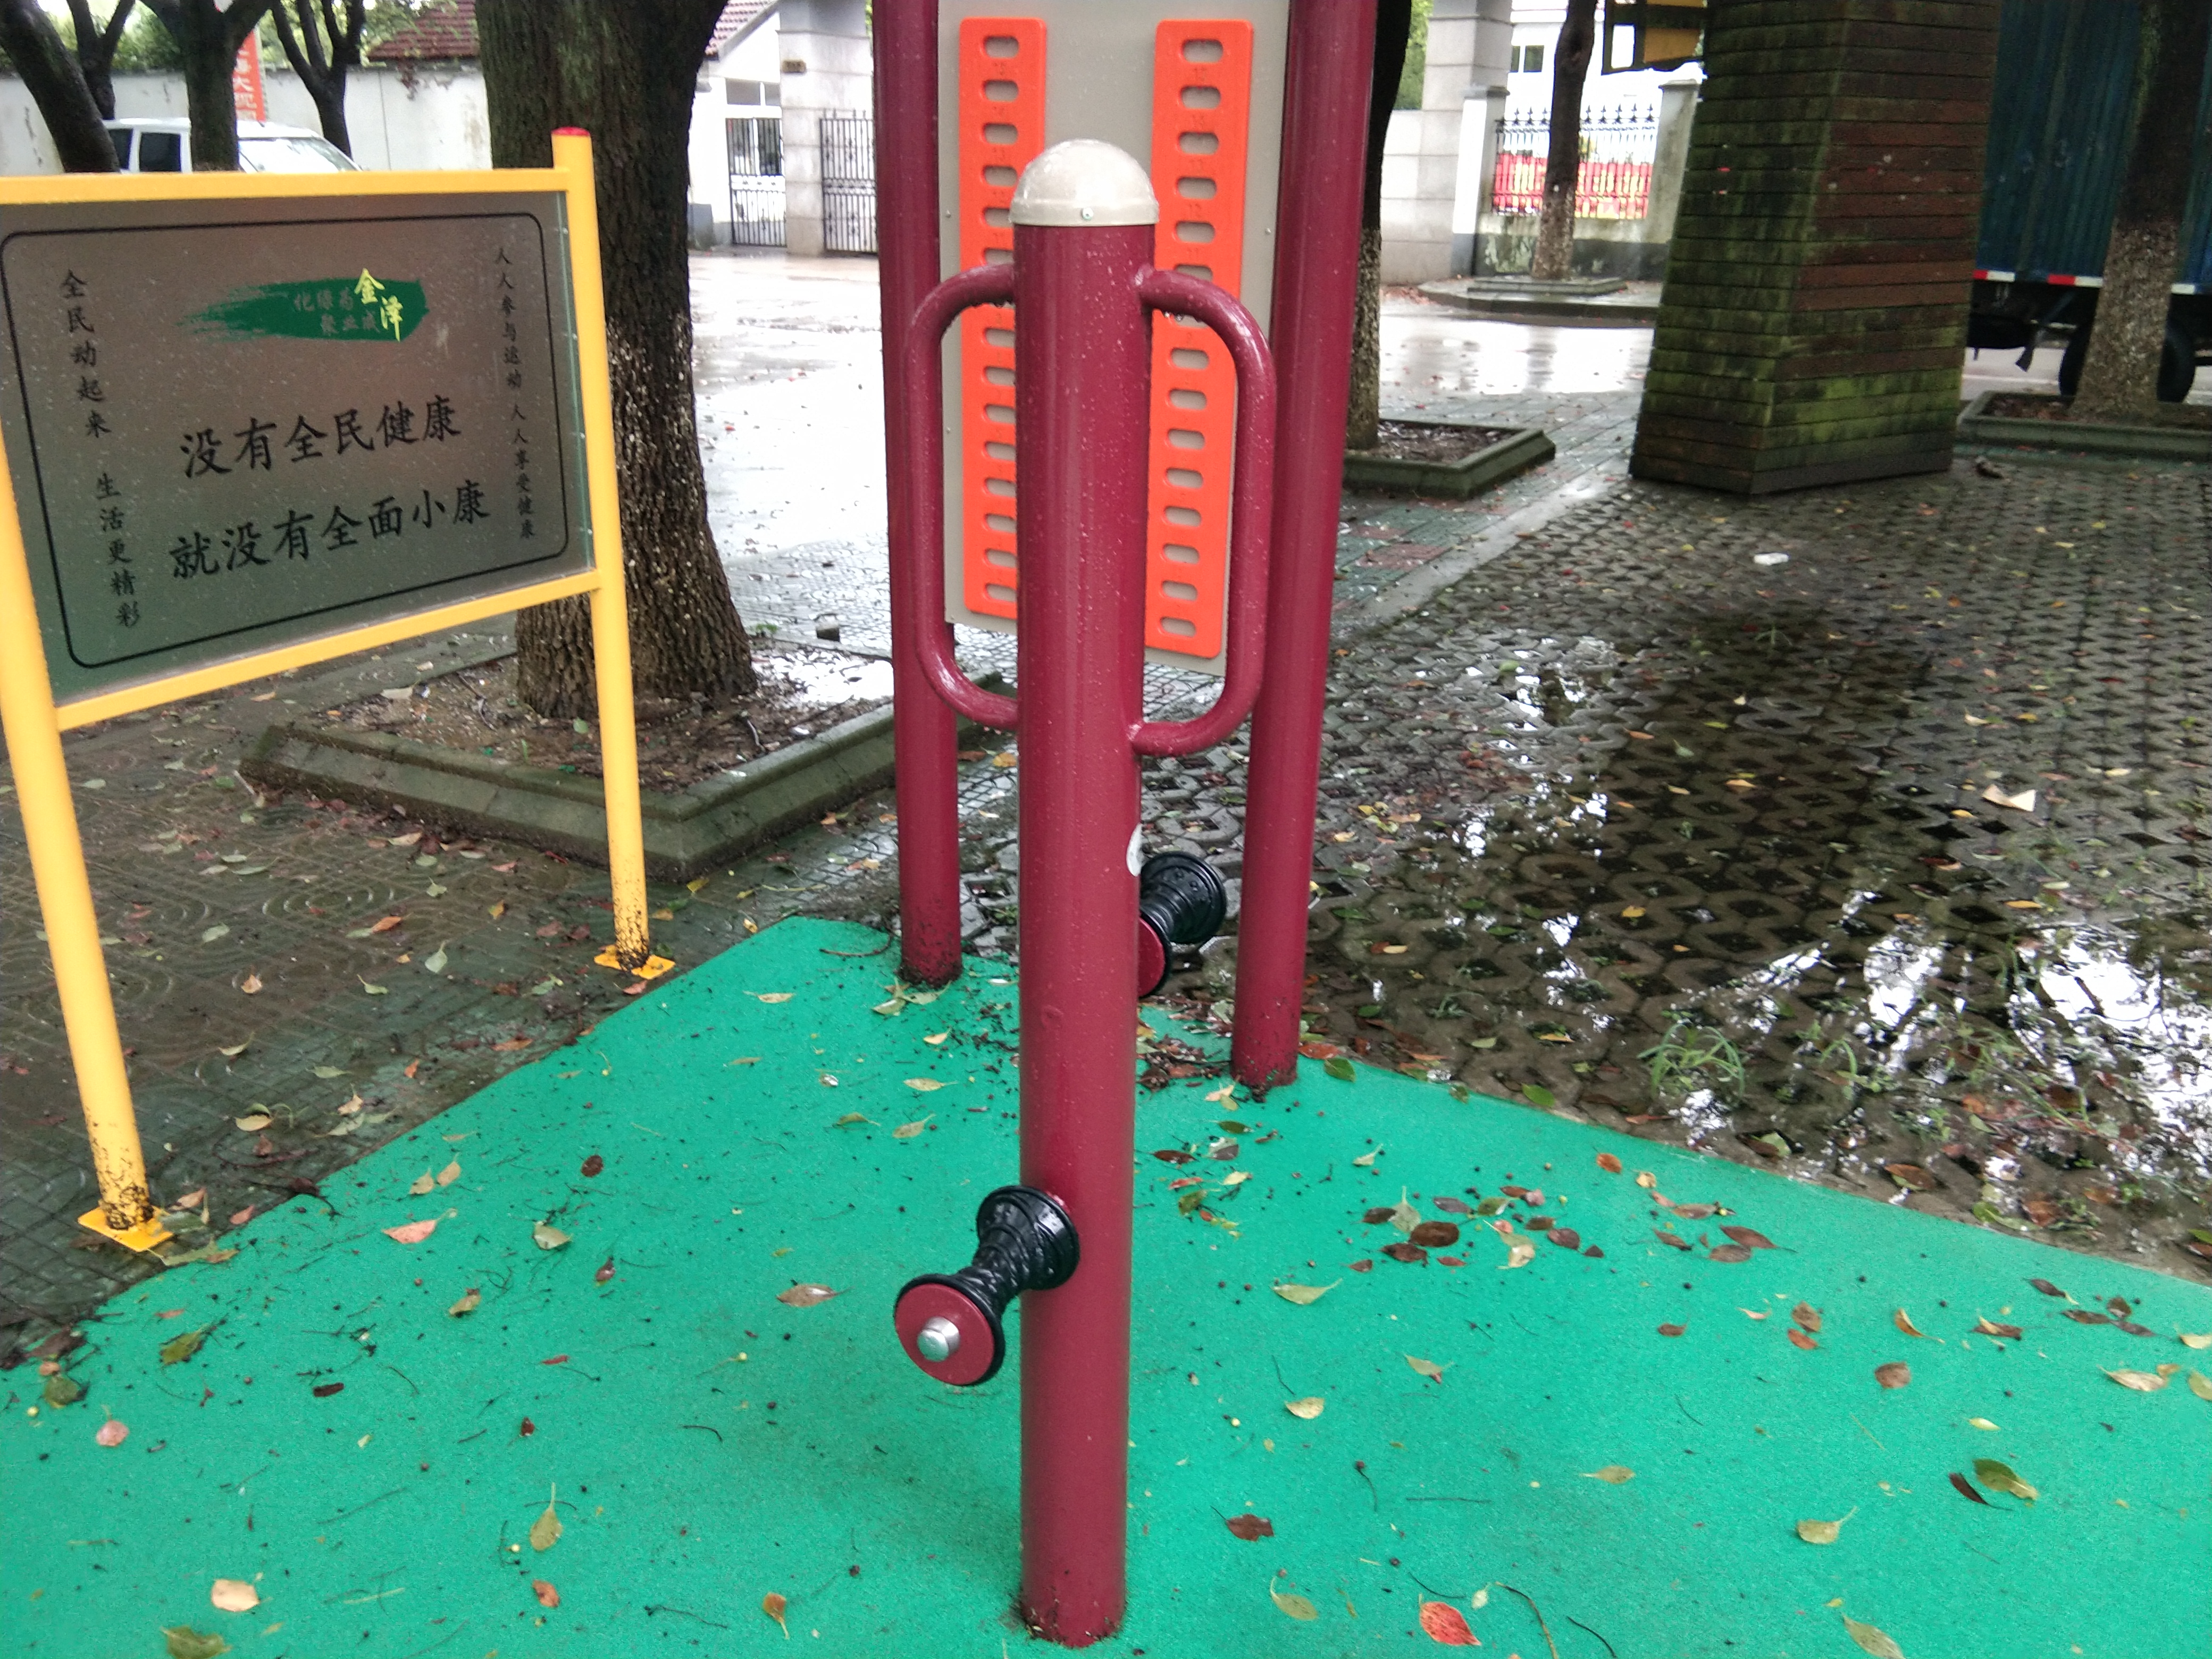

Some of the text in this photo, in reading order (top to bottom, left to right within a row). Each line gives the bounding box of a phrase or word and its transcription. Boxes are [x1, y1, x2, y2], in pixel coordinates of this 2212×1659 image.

[61, 269, 140, 627] 全民动起来 生活更精彩
[180, 394, 462, 477] 没有全民健康
[495, 248, 535, 539] 人人参与运动 人人享受健康
[170, 480, 491, 579] 就没有全面小康
